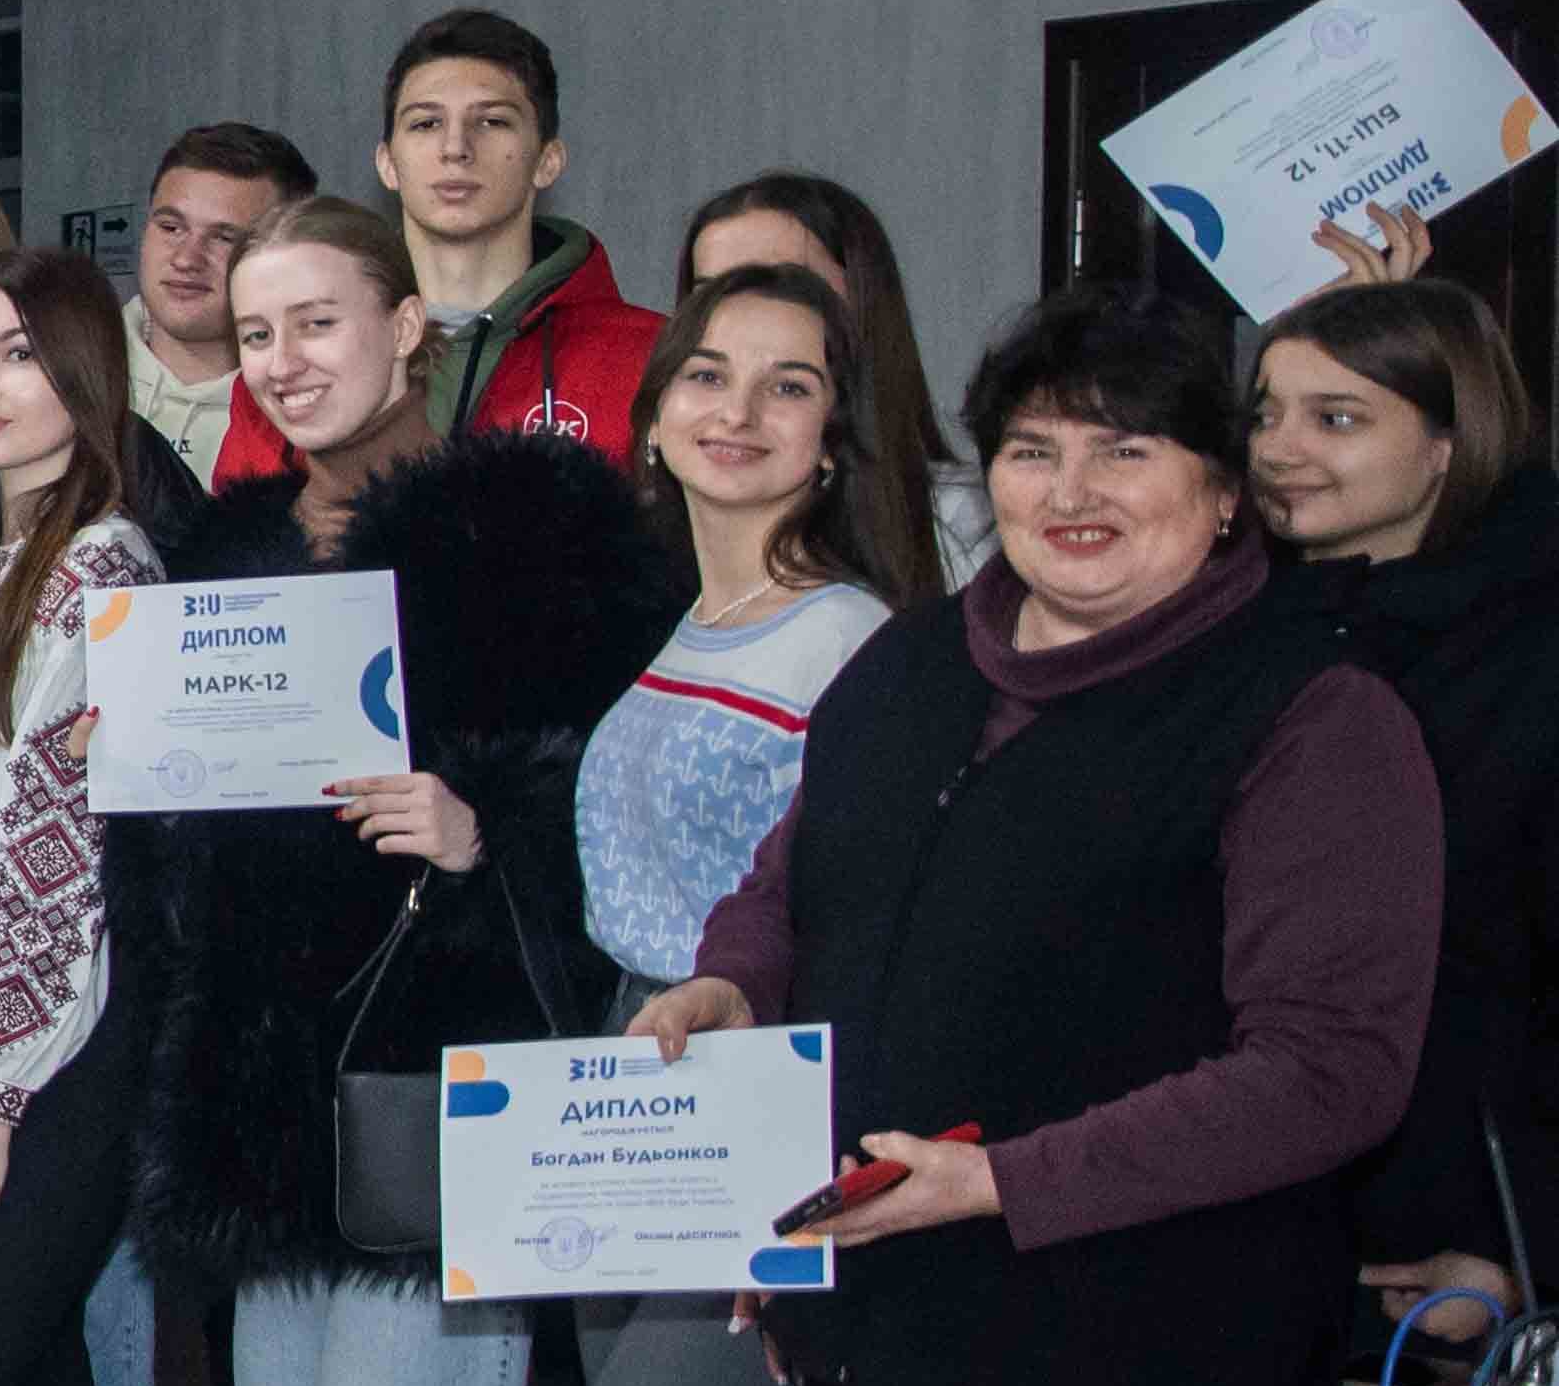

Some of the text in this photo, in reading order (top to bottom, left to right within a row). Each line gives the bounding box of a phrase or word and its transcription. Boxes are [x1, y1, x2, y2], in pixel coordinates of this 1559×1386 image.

[1284, 158, 1316, 182] 12
[1319, 139, 1429, 220] ДИПЛОМ
[181, 625, 286, 653] ДИПЛОМ
[184, 672, 289, 695] МАРК-12
[560, 1095, 696, 1125] ДИПЛОМ
[531, 1146, 729, 1167] Богдан Будьонков
